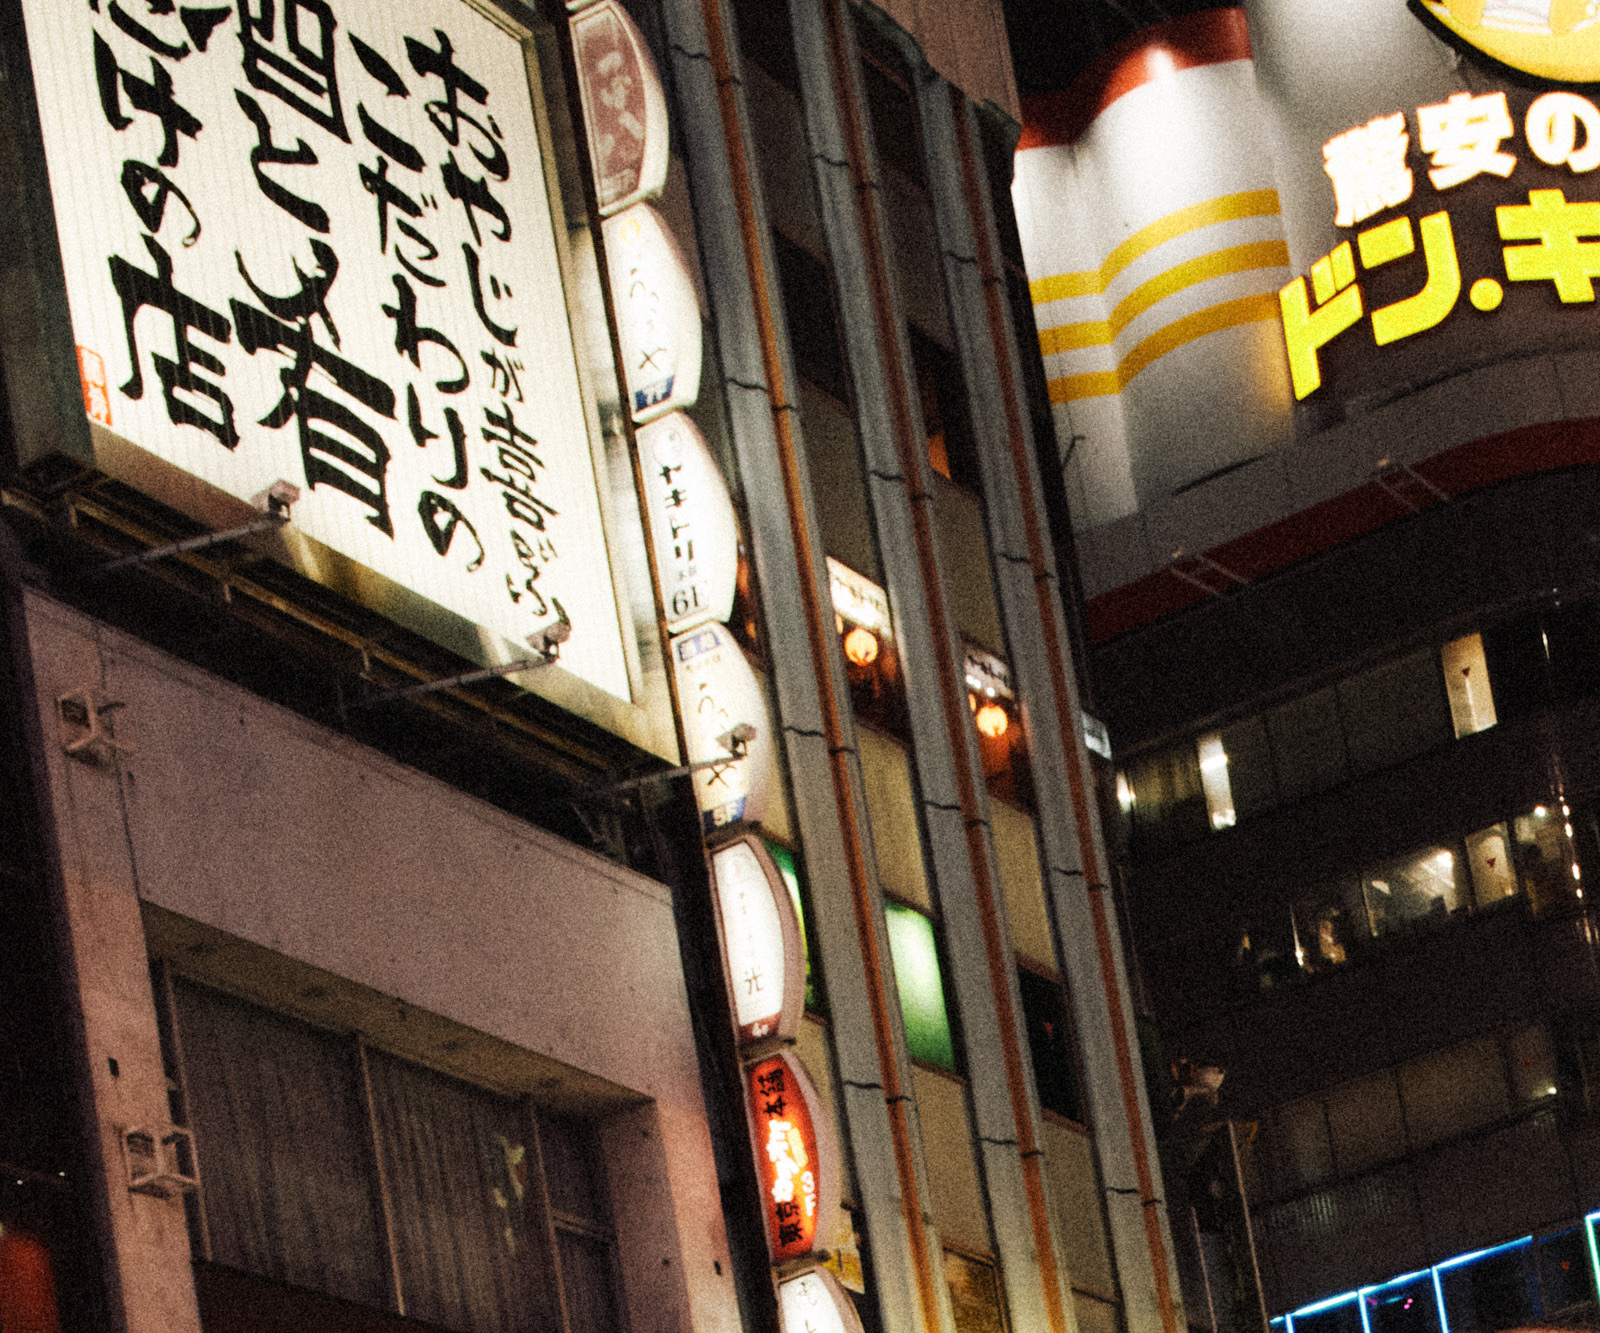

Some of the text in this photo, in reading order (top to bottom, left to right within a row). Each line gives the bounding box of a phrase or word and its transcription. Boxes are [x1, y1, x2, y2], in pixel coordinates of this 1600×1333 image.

[347, 31, 484, 572] こだわりの
